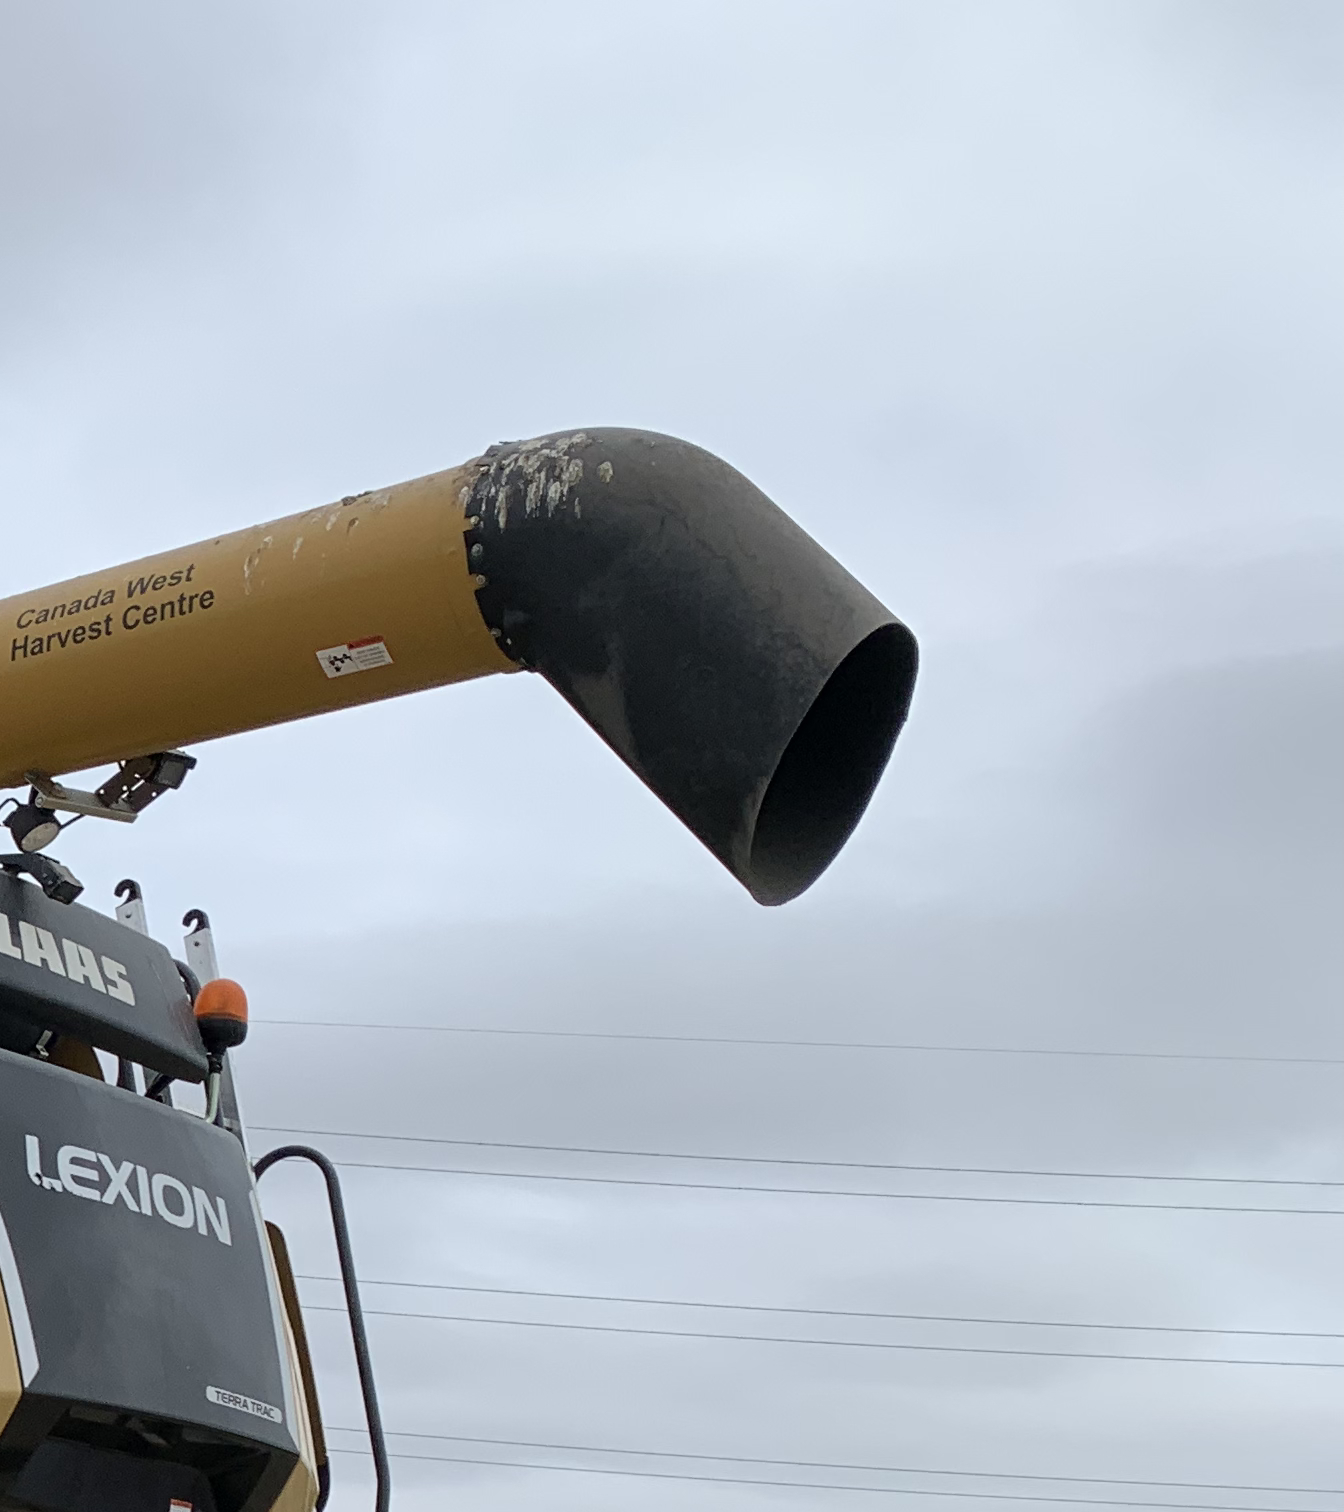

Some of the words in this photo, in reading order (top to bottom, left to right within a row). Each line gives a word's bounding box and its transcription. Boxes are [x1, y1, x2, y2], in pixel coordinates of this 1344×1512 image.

[10, 613, 113, 661] Harvest
[122, 589, 215, 630] Centre
[16, 588, 116, 629] Canada
[127, 563, 195, 598] West
[25, 1134, 232, 1247] LEXION
[215, 1390, 249, 1411] TERRA
[251, 1401, 275, 1420] TRAC
